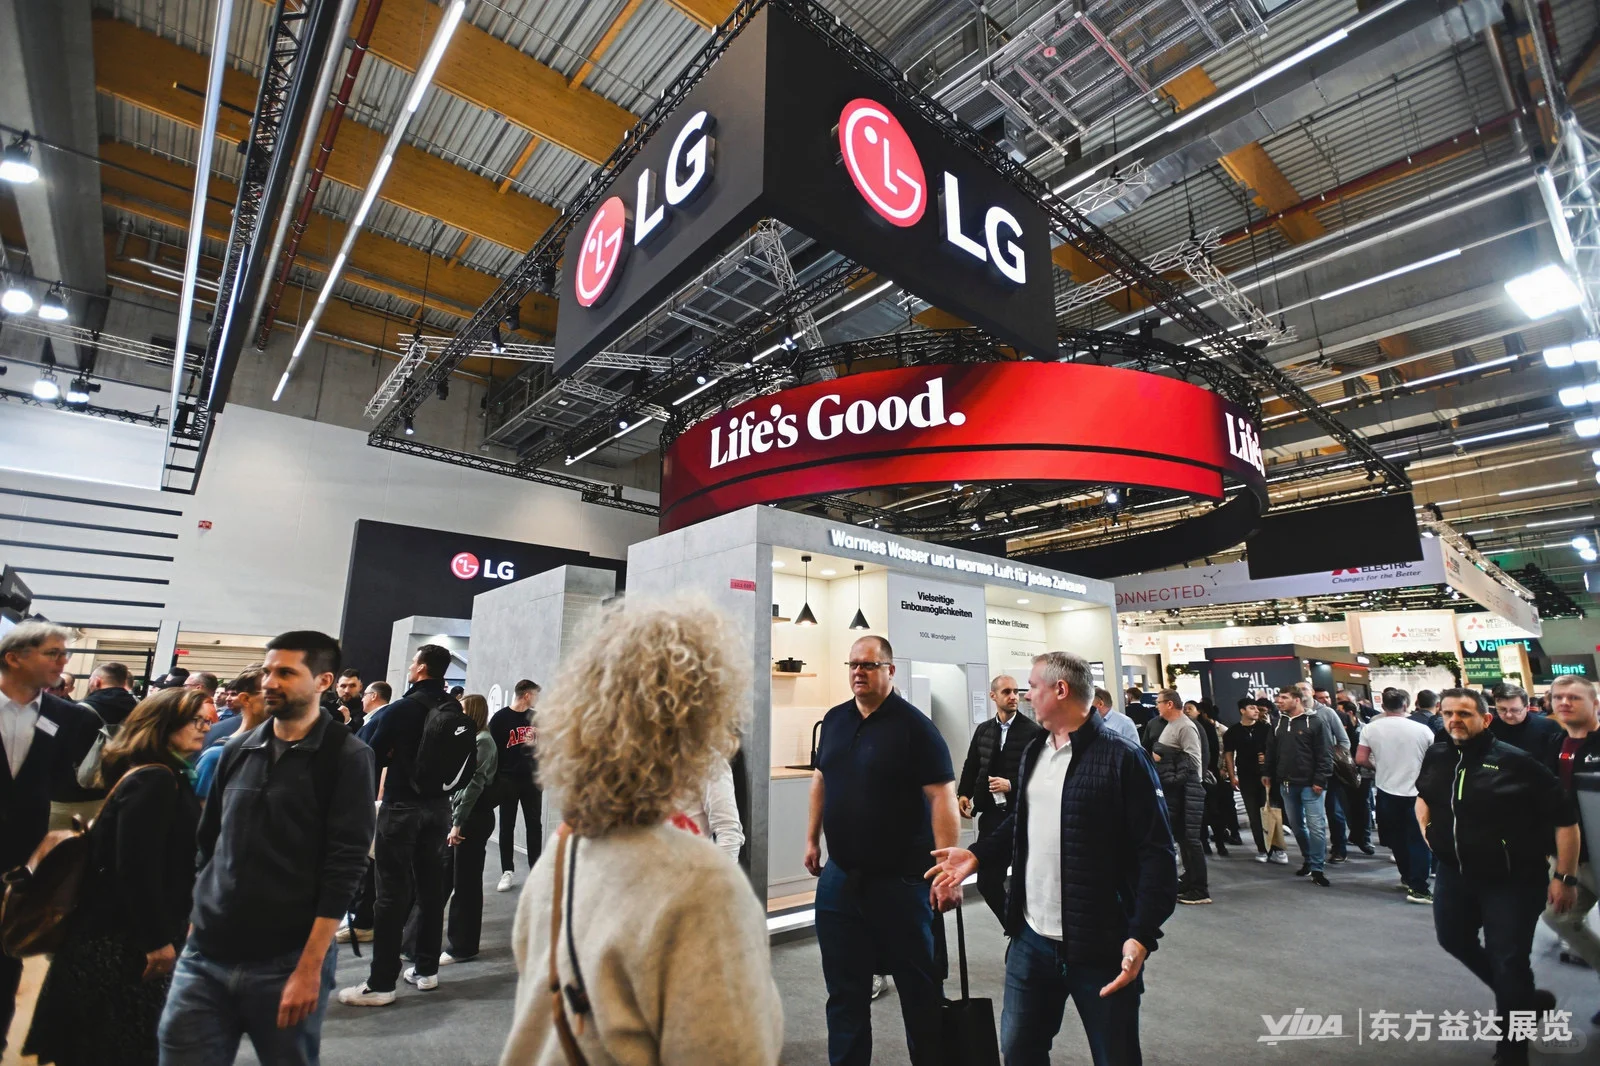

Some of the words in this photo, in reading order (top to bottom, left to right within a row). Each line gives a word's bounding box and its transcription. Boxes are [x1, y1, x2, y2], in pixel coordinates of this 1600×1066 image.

[634, 110, 709, 247] LG
[943, 170, 1027, 285] LG
[709, 403, 799, 469] Life's
[806, 376, 967, 441] Good.
[483, 559, 515, 580] LG
[830, 529, 887, 555] Warmes
[887, 541, 930, 564] Wasser
[930, 554, 955, 569] und
[956, 558, 994, 576] warme
[994, 562, 1014, 580] Luft
[1014, 567, 1028, 583] für
[1027, 570, 1053, 587] jedes
[1052, 575, 1087, 595] Zuhause
[1332, 576, 1364, 584] Changes
[1396, 570, 1422, 578] Better
[917, 591, 955, 606] Vielseitige
[901, 600, 973, 618] Einbaumöglichkeiten
[988, 618, 997, 626] mit
[997, 618, 1011, 627] hoher
[1249, 671, 1269, 688] ALL
